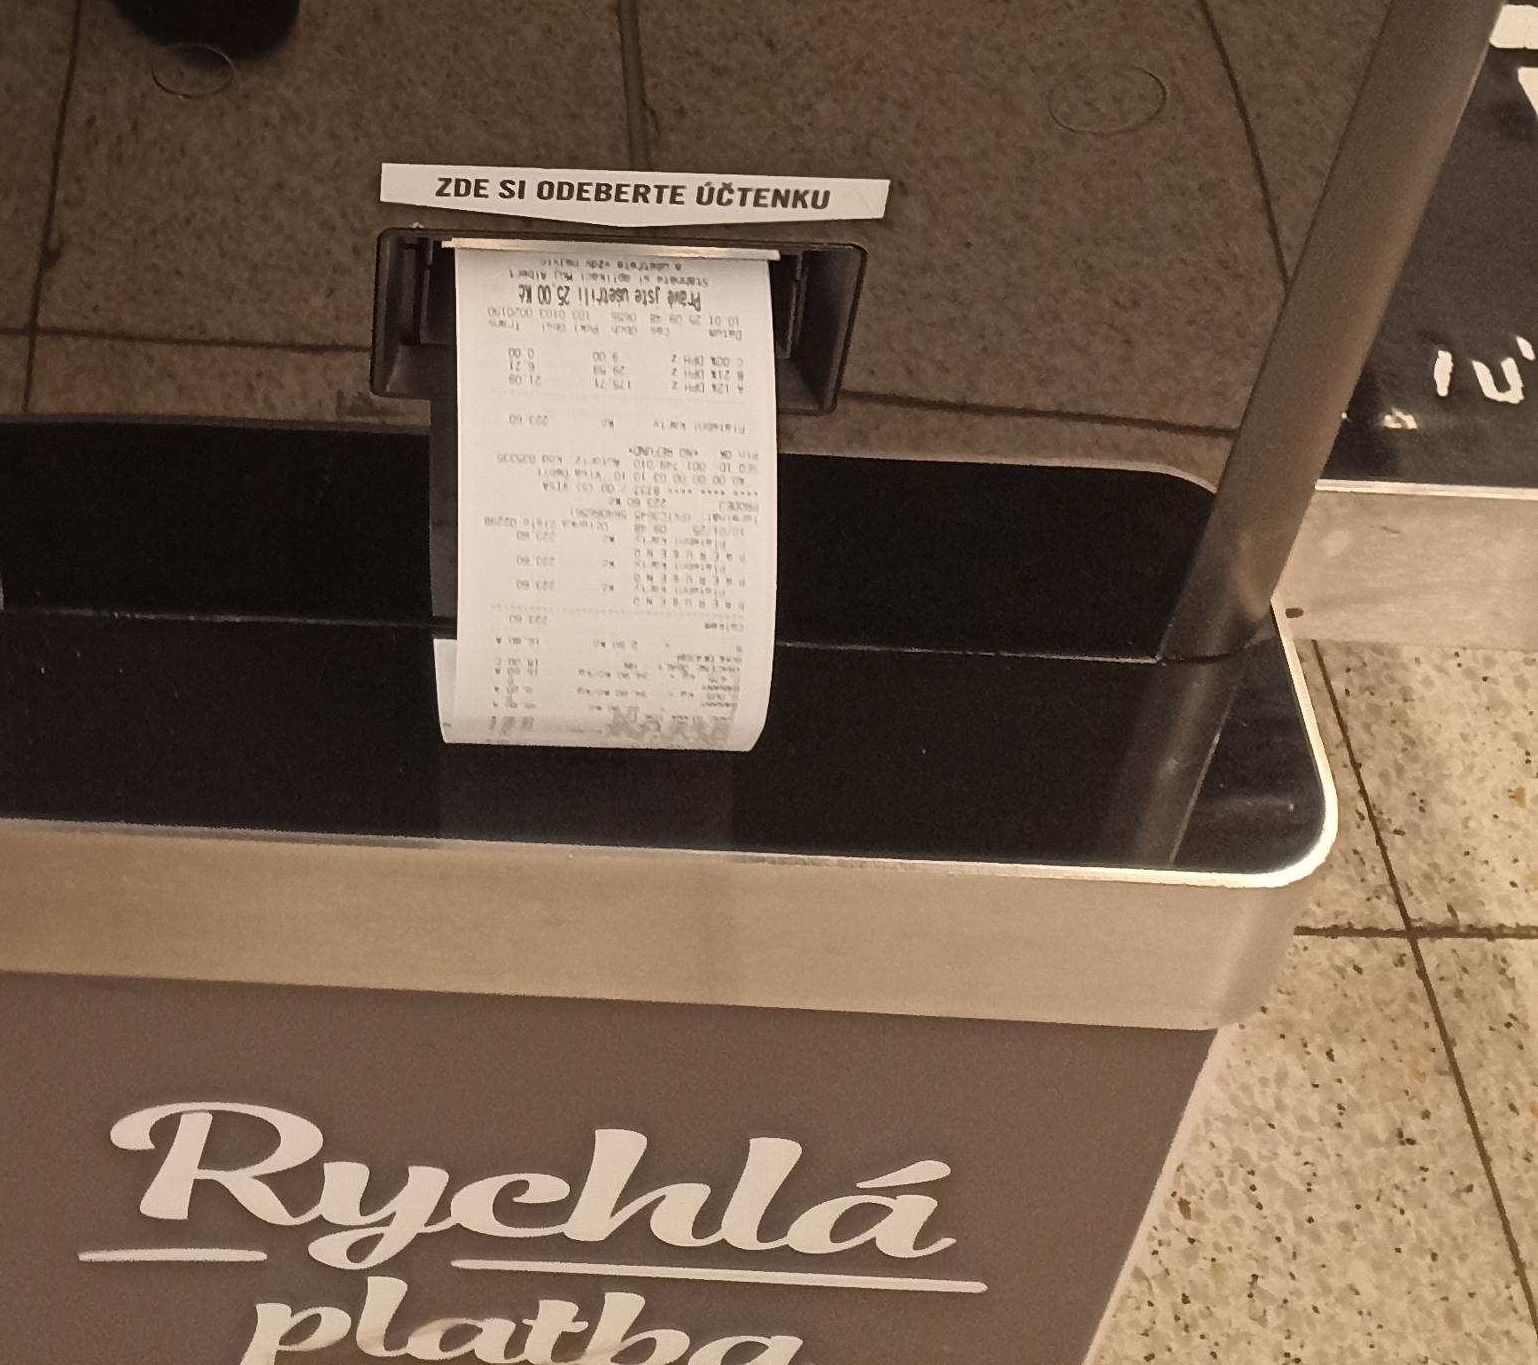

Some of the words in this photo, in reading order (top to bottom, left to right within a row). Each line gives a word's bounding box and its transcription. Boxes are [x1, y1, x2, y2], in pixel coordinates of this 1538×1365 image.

[434, 176, 490, 199] ZDE
[498, 178, 526, 201] SI
[535, 180, 687, 206] ODEBERTE
[695, 180, 832, 211] ÚČTENKU
[634, 286, 661, 307] jste
[109, 1101, 957, 1271] Rychlá
[236, 1275, 804, 1365] platba
